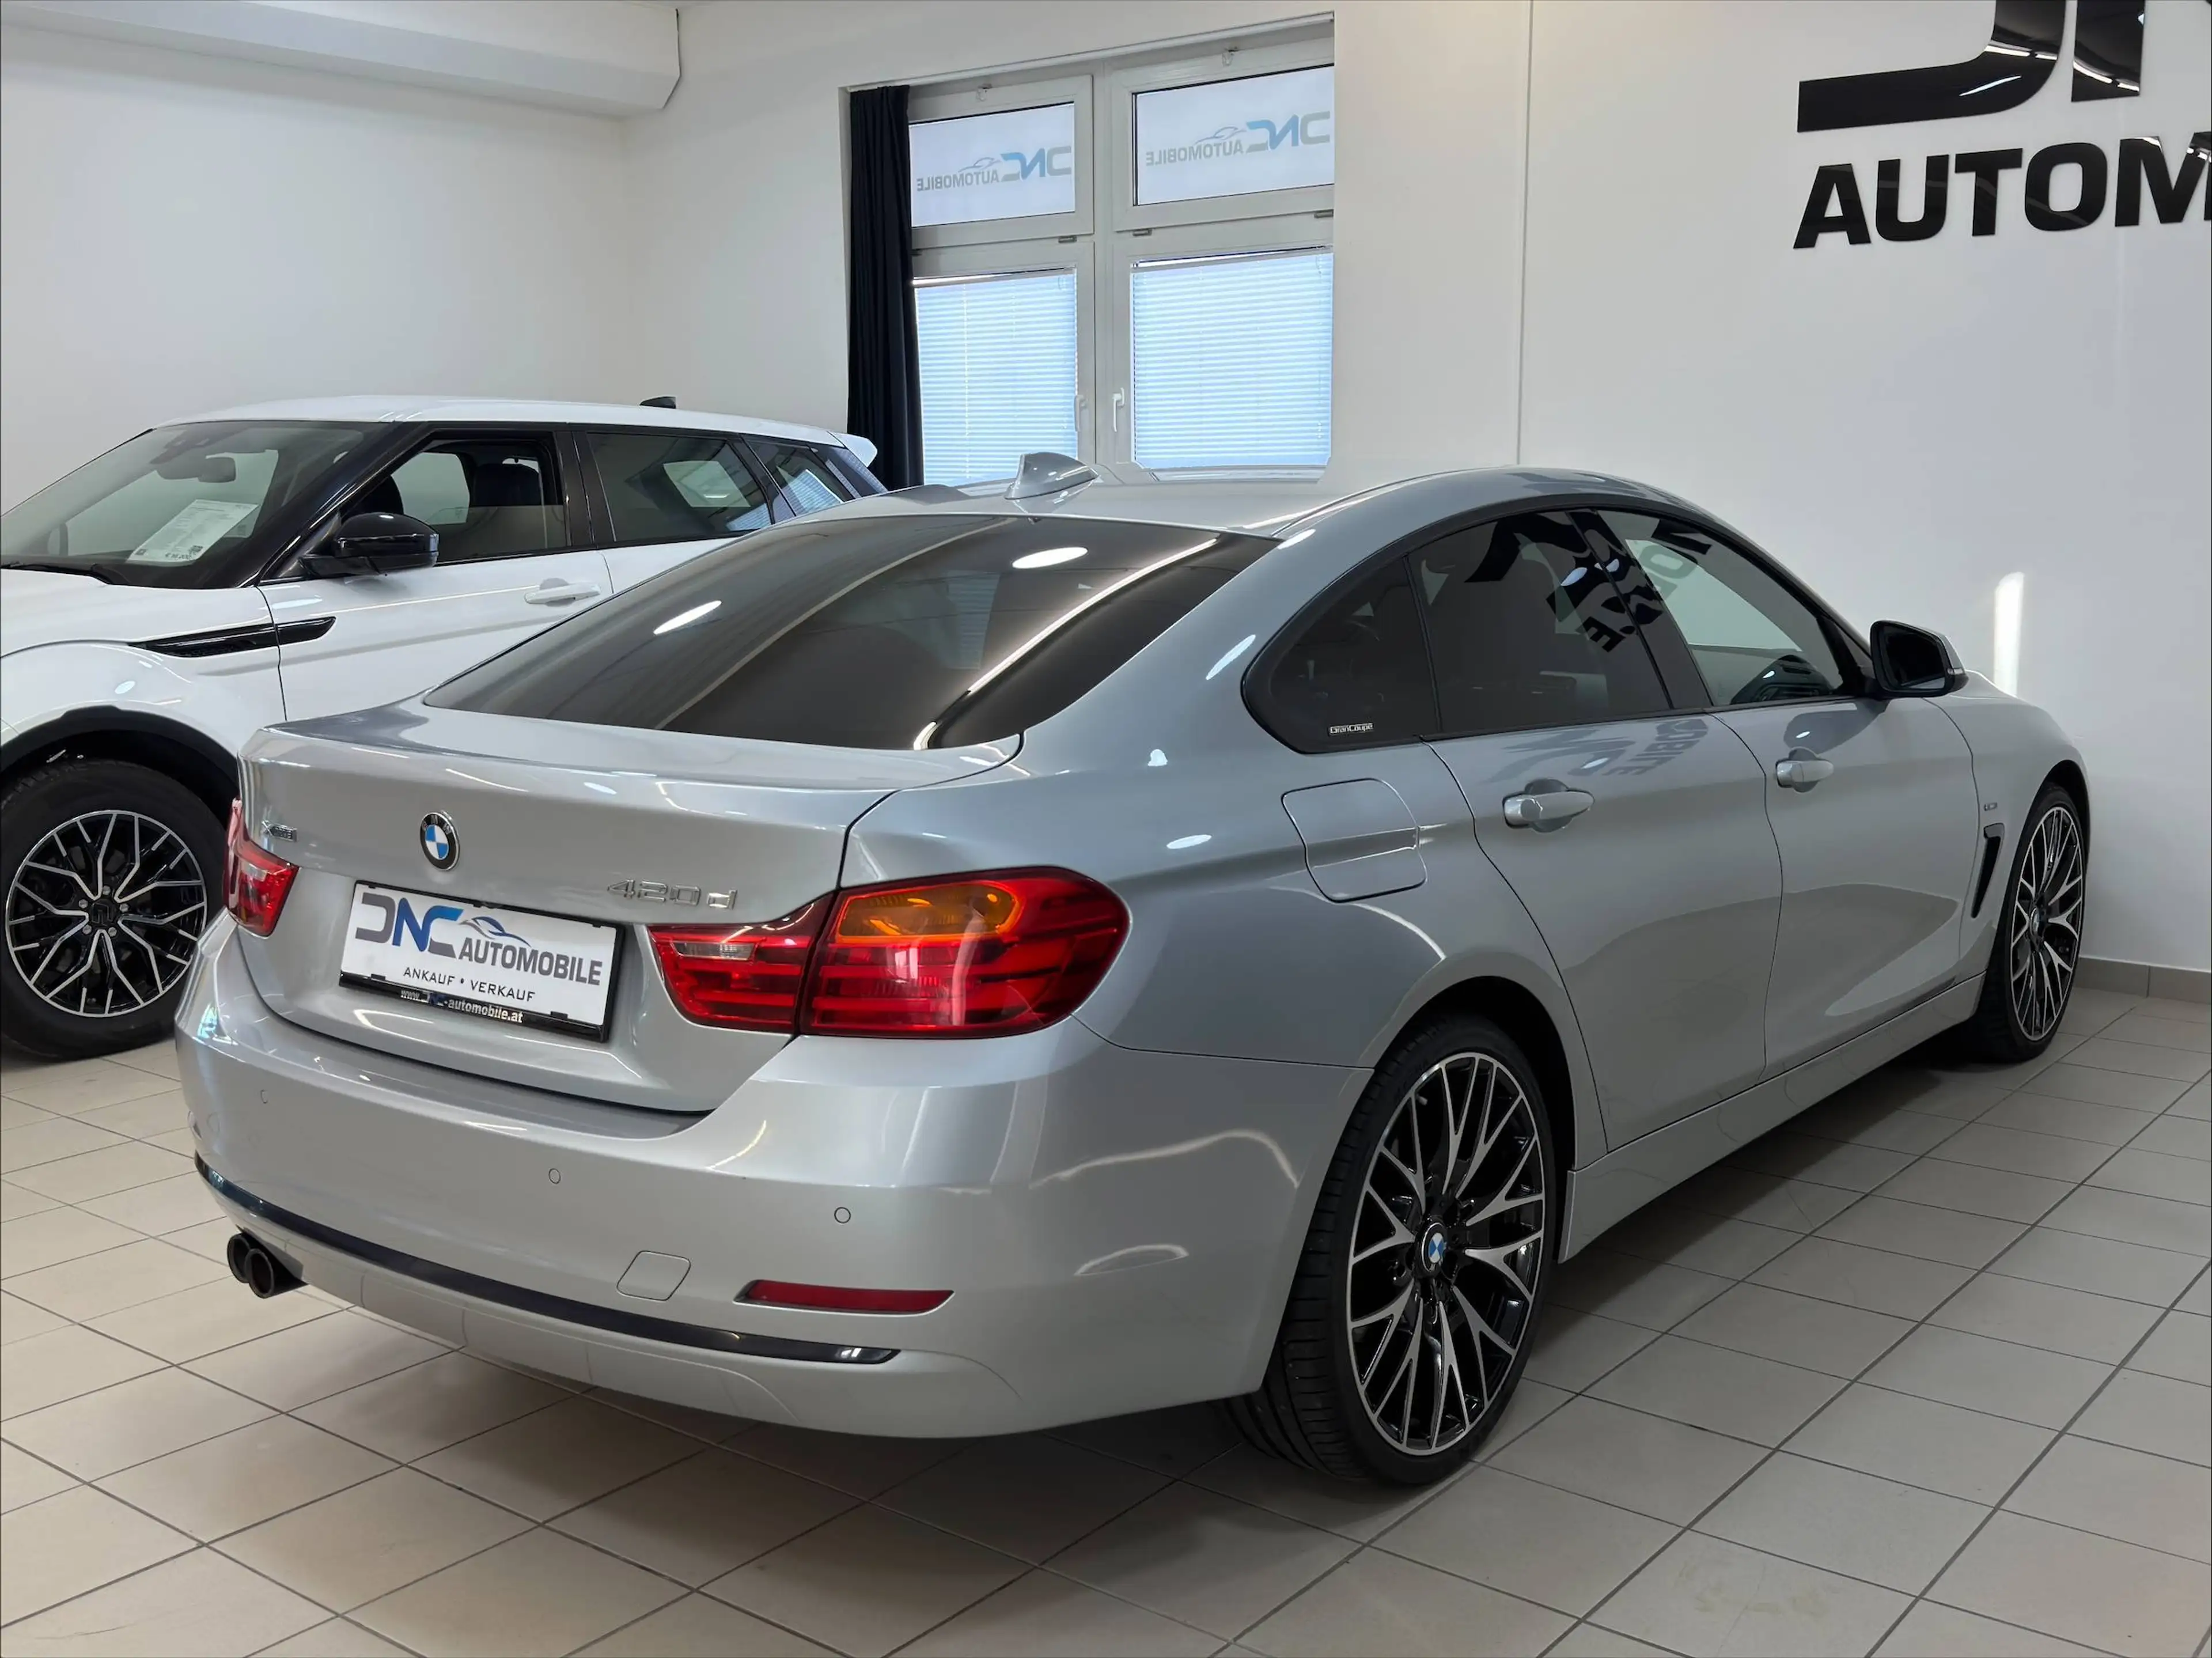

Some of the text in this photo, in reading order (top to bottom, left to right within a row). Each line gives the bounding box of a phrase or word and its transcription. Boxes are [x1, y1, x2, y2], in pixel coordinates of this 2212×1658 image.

[459, 937, 603, 986] AUTOMOBILE
[403, 967, 536, 1002] ANKAUF VERKAUF
